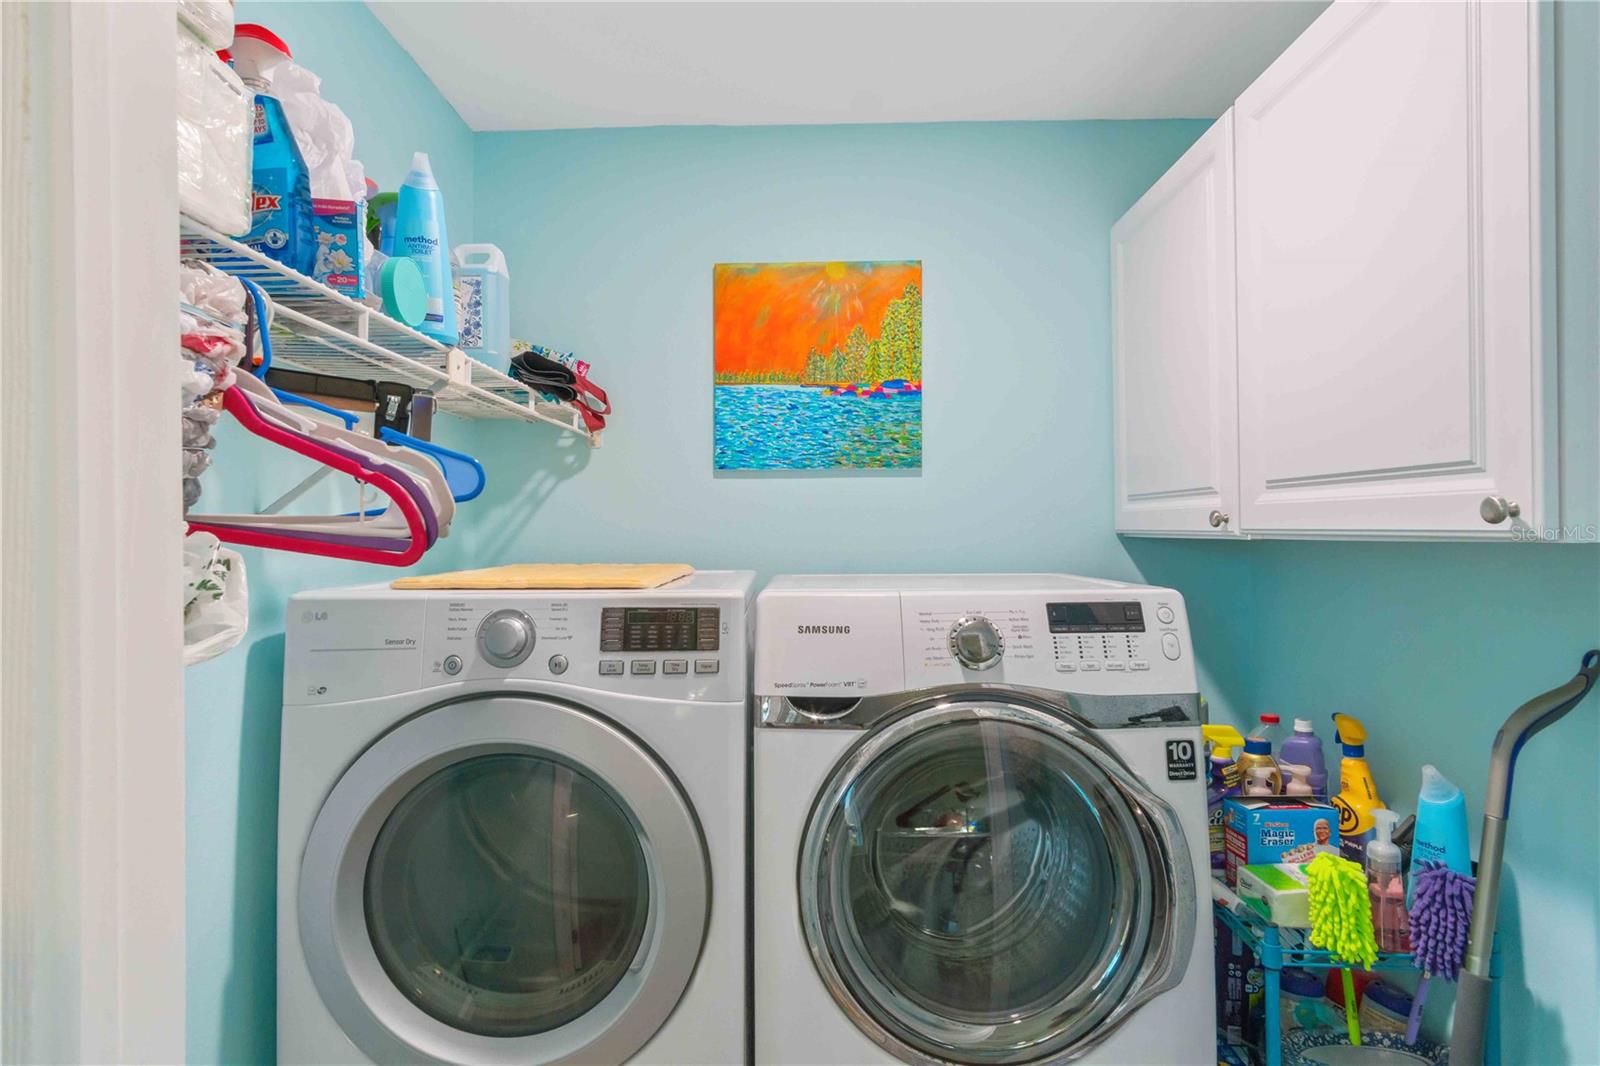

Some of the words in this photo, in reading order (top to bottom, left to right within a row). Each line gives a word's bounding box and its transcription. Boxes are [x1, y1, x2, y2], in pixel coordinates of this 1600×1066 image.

[404, 235, 438, 246] method
[337, 276, 348, 284] 20
[315, 612, 328, 621] LG
[797, 625, 851, 634] SAMSUNG
[405, 638, 416, 646] Dry
[1168, 742, 1192, 761] 10
[1253, 813, 1260, 822] 7
[1260, 829, 1294, 840] Magic
[1260, 838, 1294, 846] Eraser
